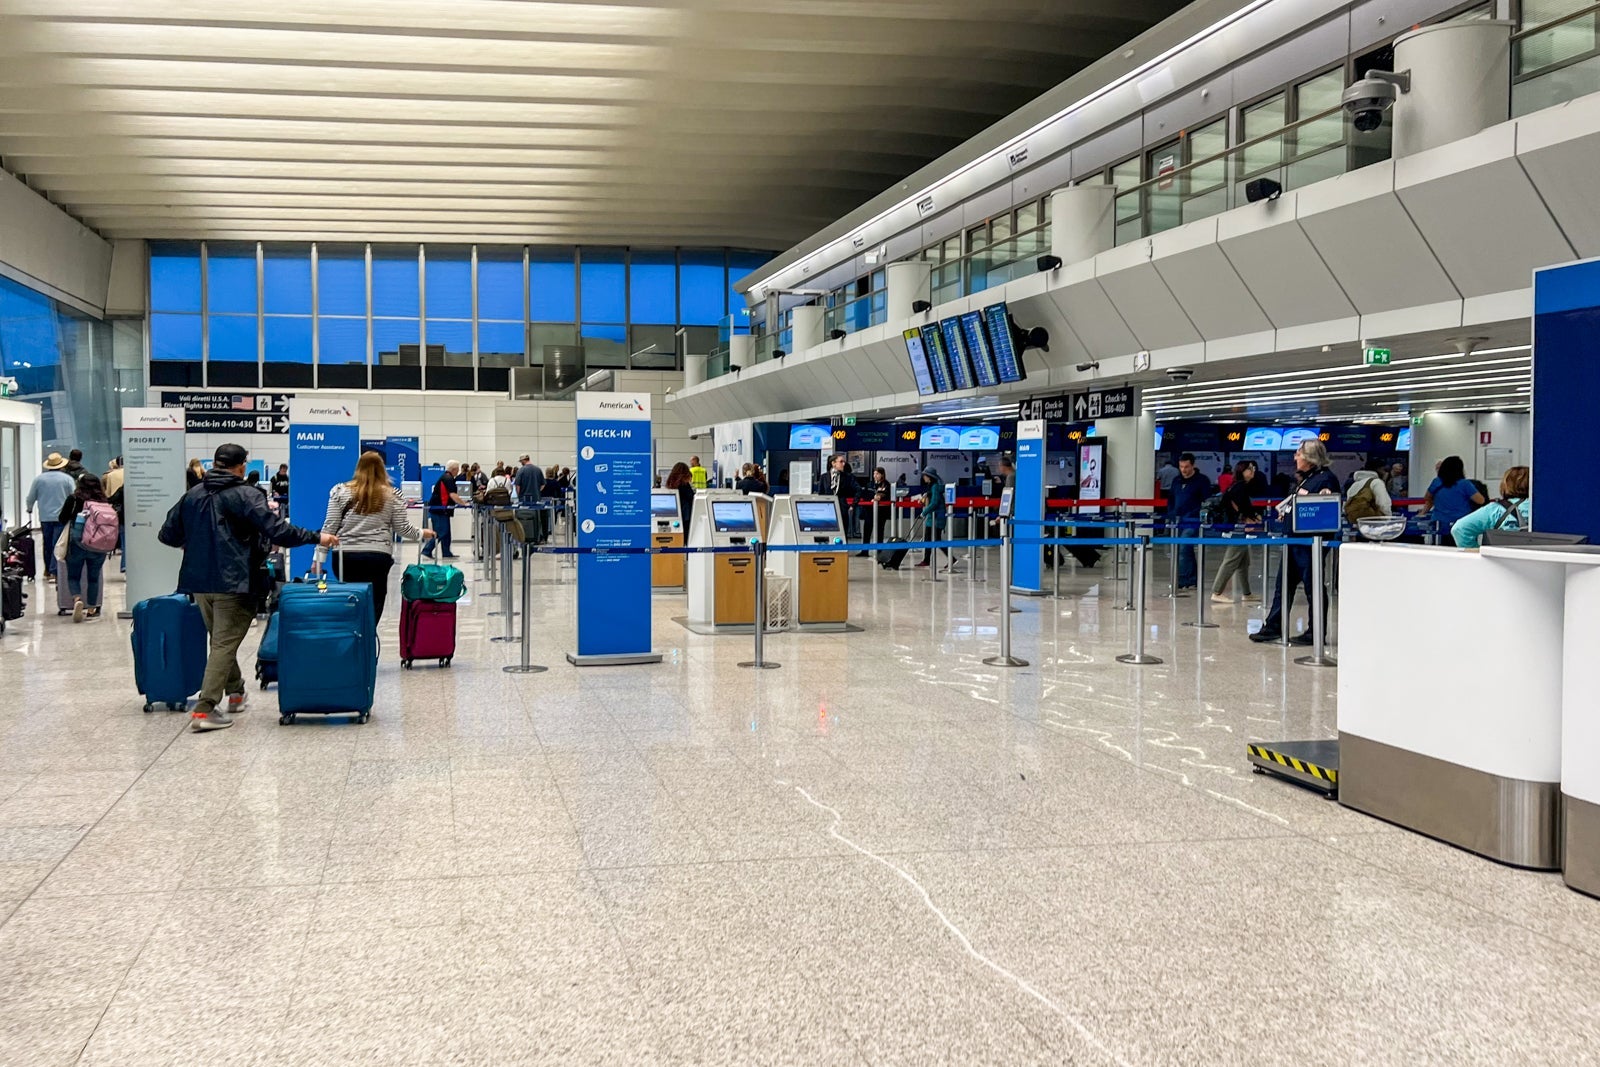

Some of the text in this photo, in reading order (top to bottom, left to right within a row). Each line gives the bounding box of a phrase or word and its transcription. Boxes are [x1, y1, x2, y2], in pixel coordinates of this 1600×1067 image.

[1104, 393, 1128, 403] Check-in
[184, 402, 203, 410] flights
[598, 401, 634, 409] American
[1044, 401, 1064, 410] Check-in
[309, 407, 342, 415] American
[186, 420, 254, 428] Check-in 410-430
[296, 432, 325, 441] MAIN
[584, 428, 632, 438] CHECK-IN
[832, 430, 846, 440] 409
[901, 430, 917, 440] 408
[1227, 431, 1241, 441] 404
[1379, 432, 1394, 442] 402
